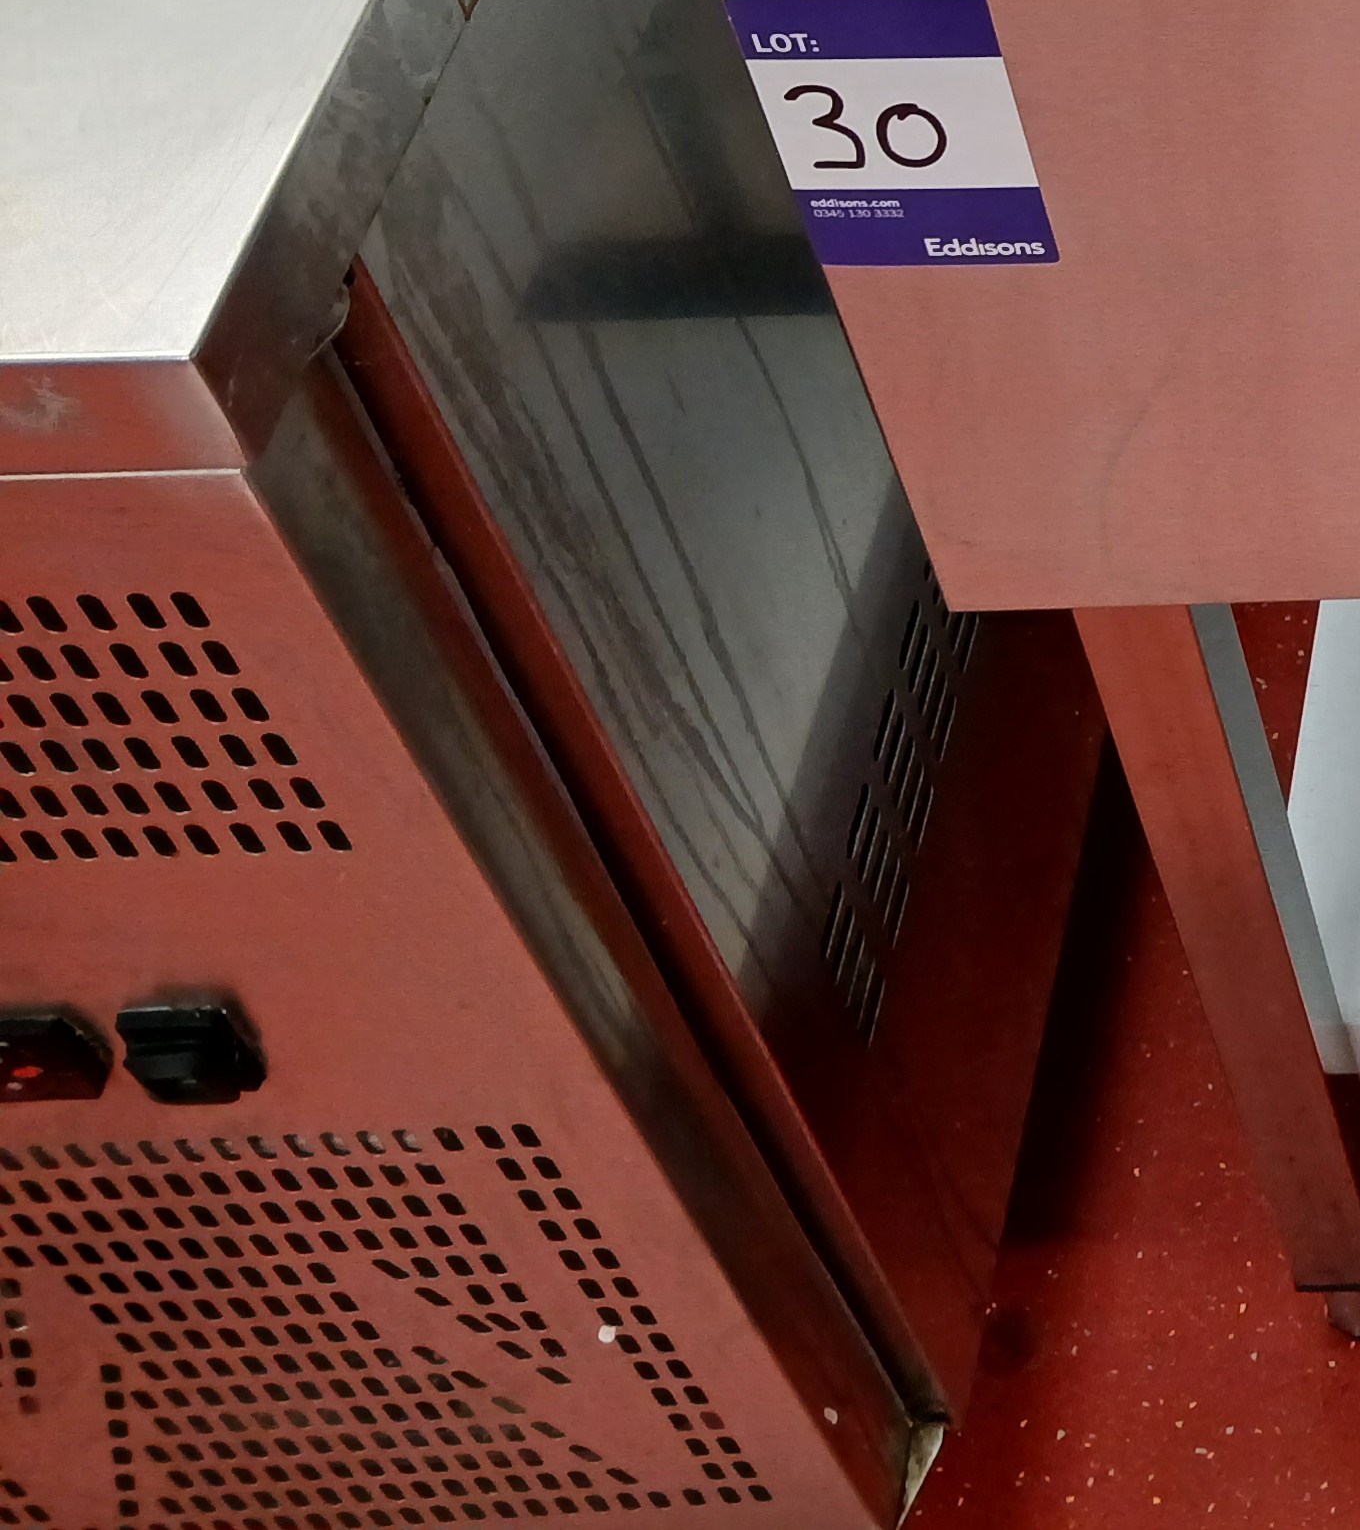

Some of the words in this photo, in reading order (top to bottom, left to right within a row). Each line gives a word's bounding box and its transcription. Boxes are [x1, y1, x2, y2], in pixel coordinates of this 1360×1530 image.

[751, 32, 820, 53] LOT:
[783, 84, 948, 169] 30
[810, 198, 900, 208] eddisons.com
[848, 209, 872, 218] 130
[923, 237, 1046, 257] Eddisons
